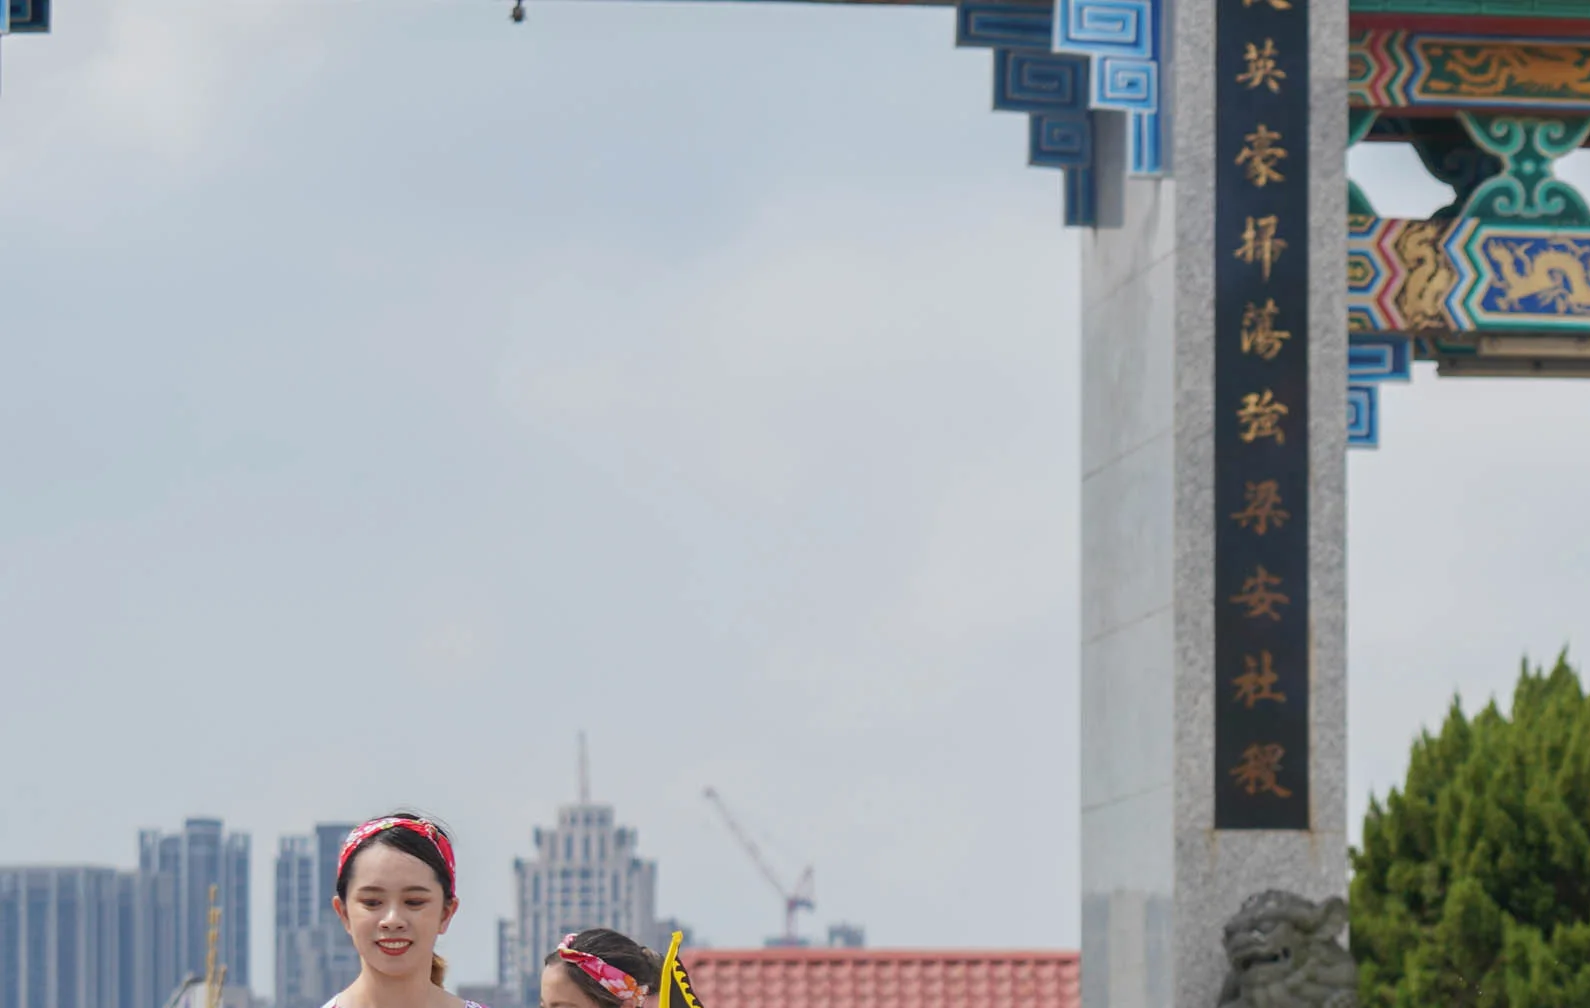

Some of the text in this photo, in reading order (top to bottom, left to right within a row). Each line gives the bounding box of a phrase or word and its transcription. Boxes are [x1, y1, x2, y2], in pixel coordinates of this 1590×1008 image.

[1229, 0, 1294, 799] 英豪掃蕩強梁安社稷
